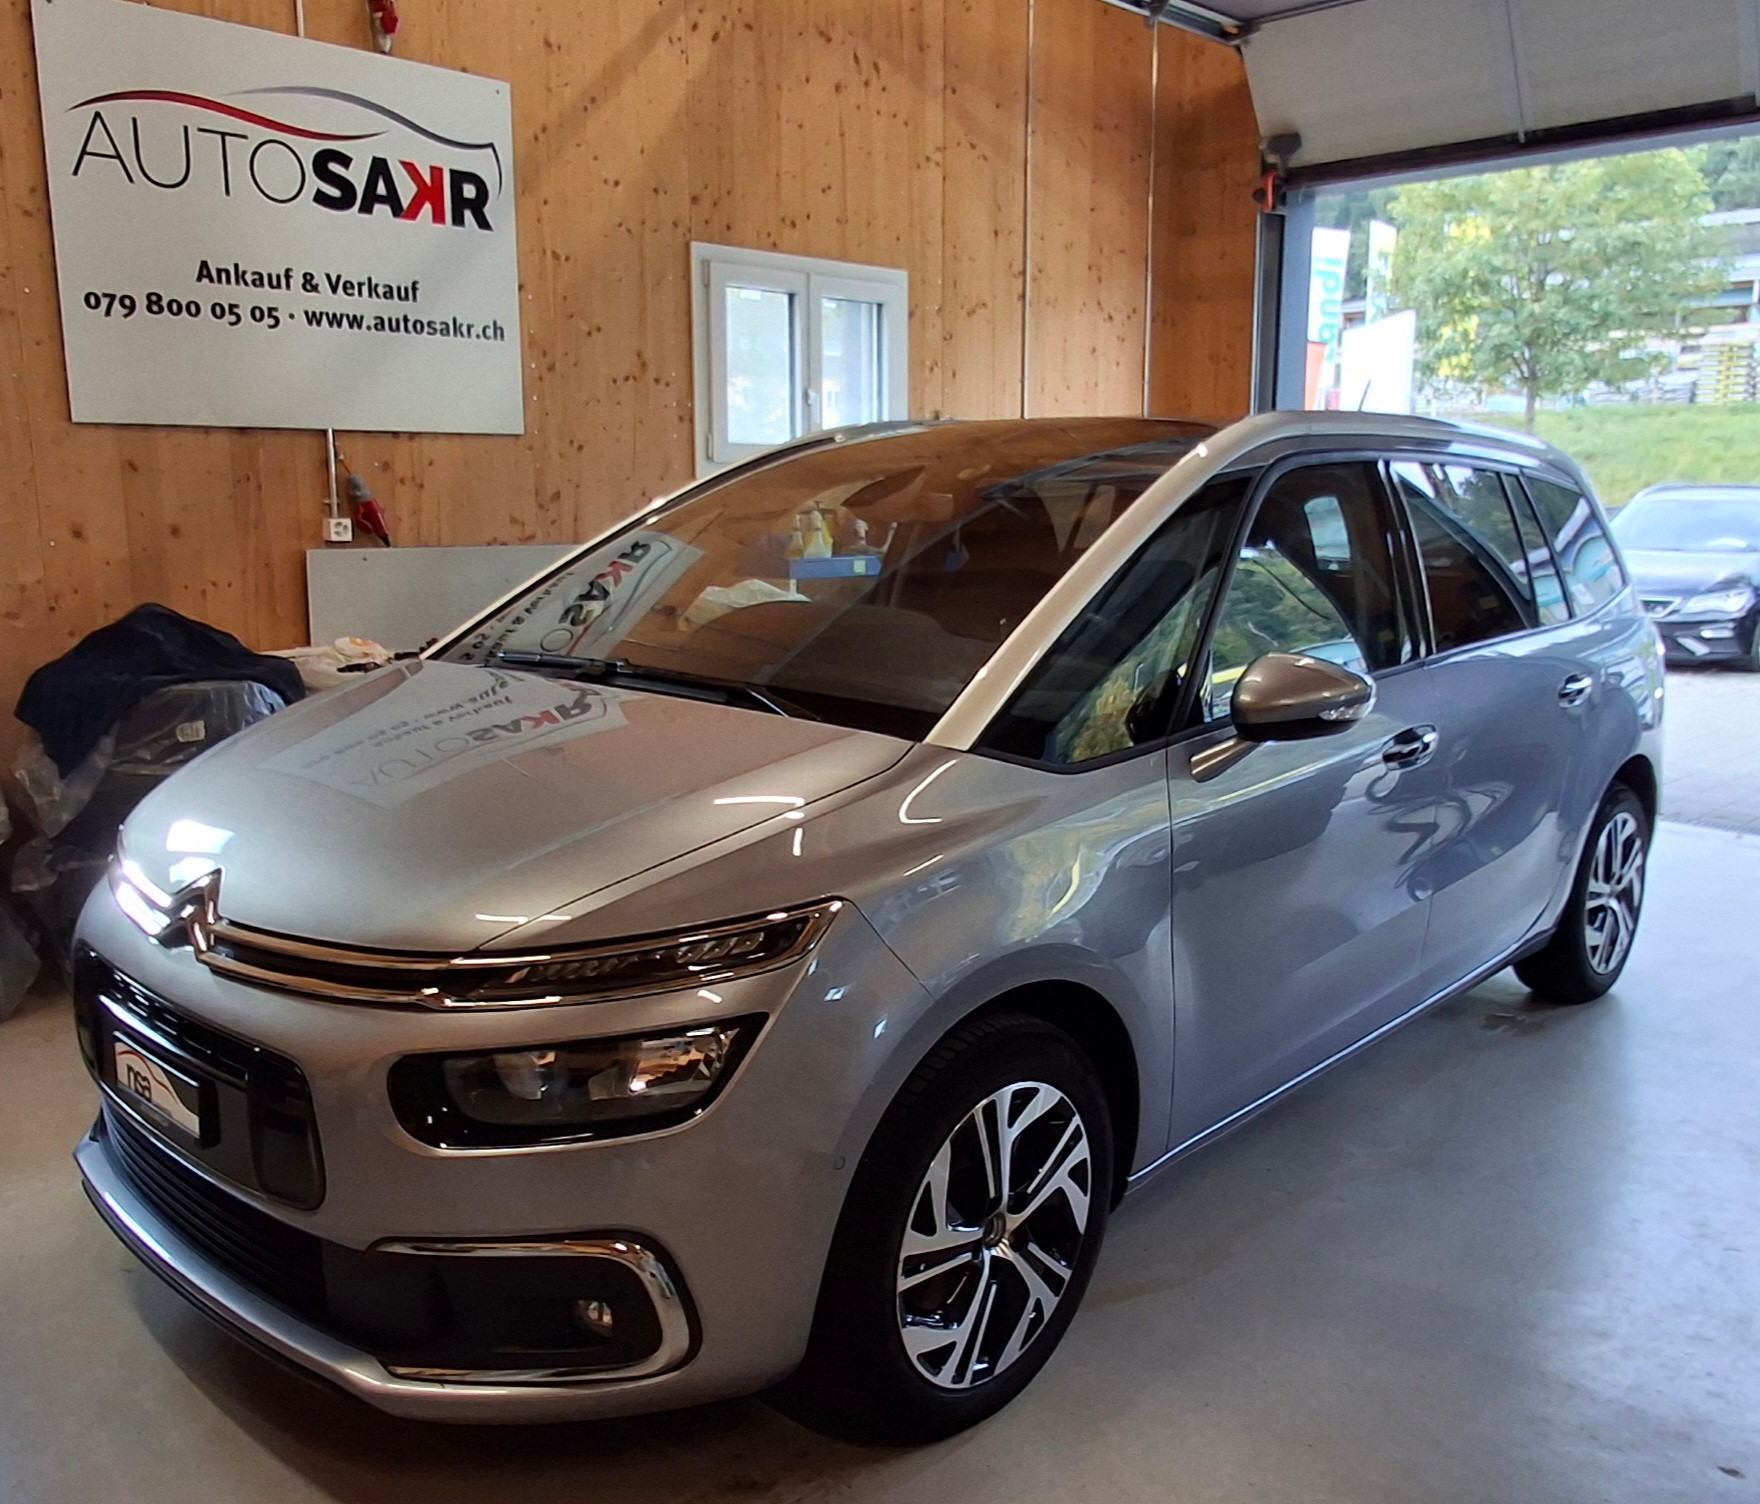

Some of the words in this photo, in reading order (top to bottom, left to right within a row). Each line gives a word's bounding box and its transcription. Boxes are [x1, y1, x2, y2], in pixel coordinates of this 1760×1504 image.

[195, 259, 294, 292] Ankauf
[300, 271, 322, 295] &
[323, 272, 420, 304] Verkauf
[83, 291, 137, 320] 079
[145, 291, 202, 319] 800
[210, 301, 242, 327] 05
[249, 305, 281, 330] 05
[302, 309, 505, 342] www.autosakr.ch
